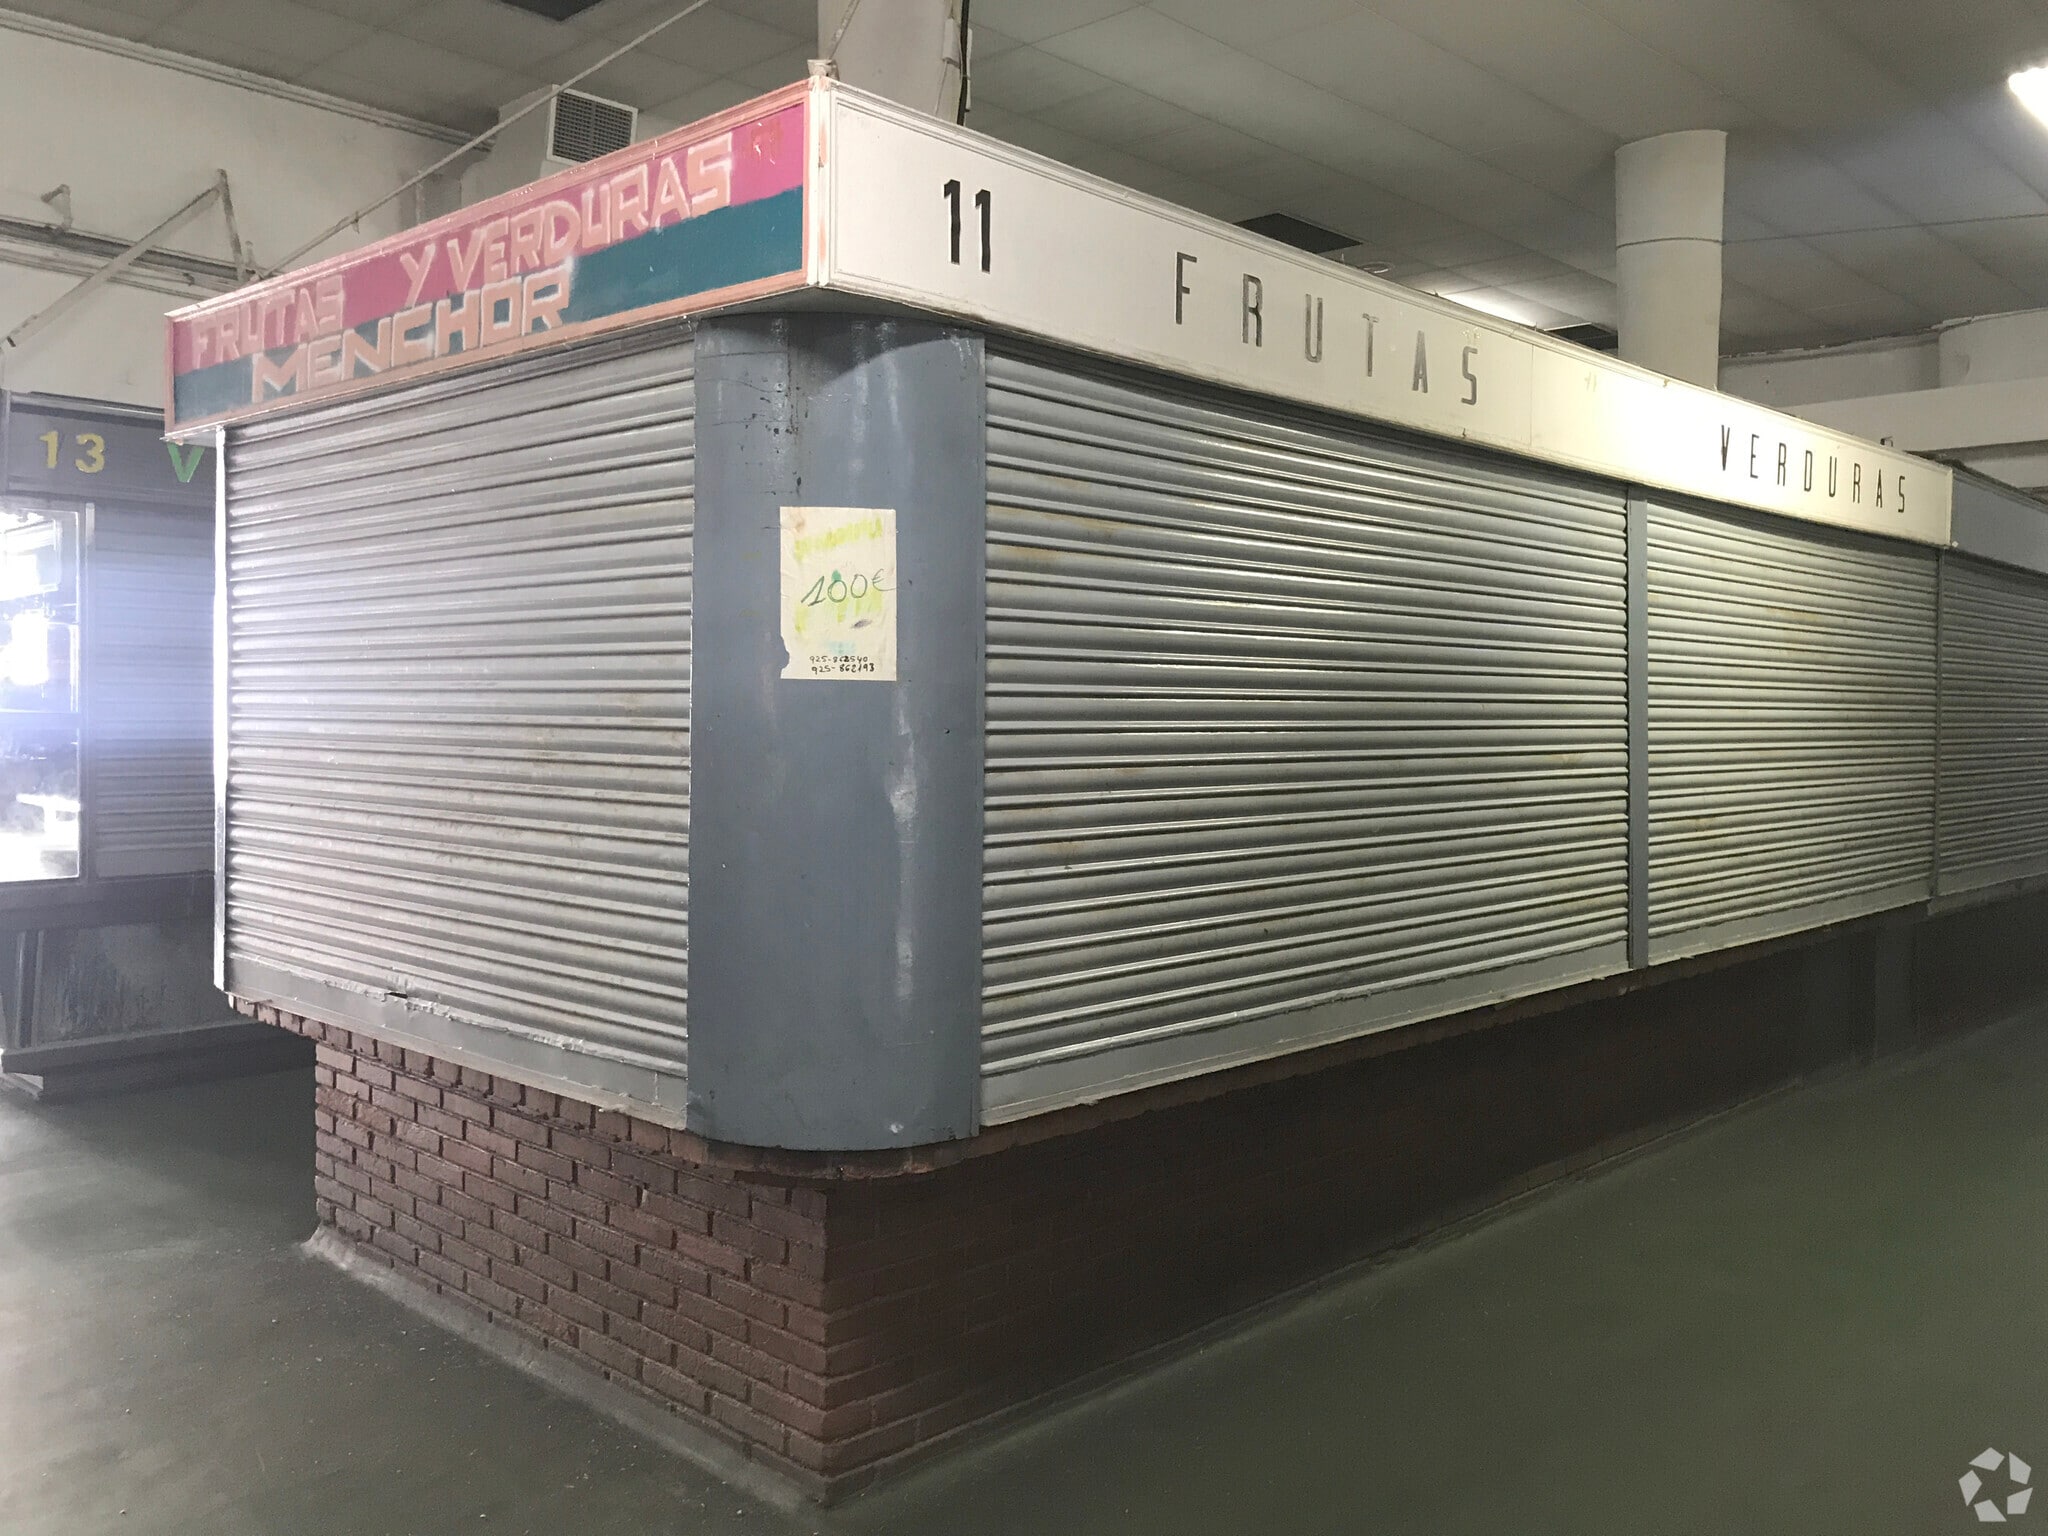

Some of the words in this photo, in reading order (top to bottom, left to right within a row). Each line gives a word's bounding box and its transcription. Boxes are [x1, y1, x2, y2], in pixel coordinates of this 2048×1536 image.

[191, 273, 345, 370] FRUTAS
[400, 243, 436, 309] Y
[446, 131, 733, 293] VERDURAS
[251, 262, 574, 404] MENCHOR
[943, 179, 992, 274] 11
[1176, 251, 1479, 406] FRUTAS
[1720, 424, 1906, 514] VERDURAS
[38, 430, 106, 474] 13
[800, 568, 900, 608] 100€
